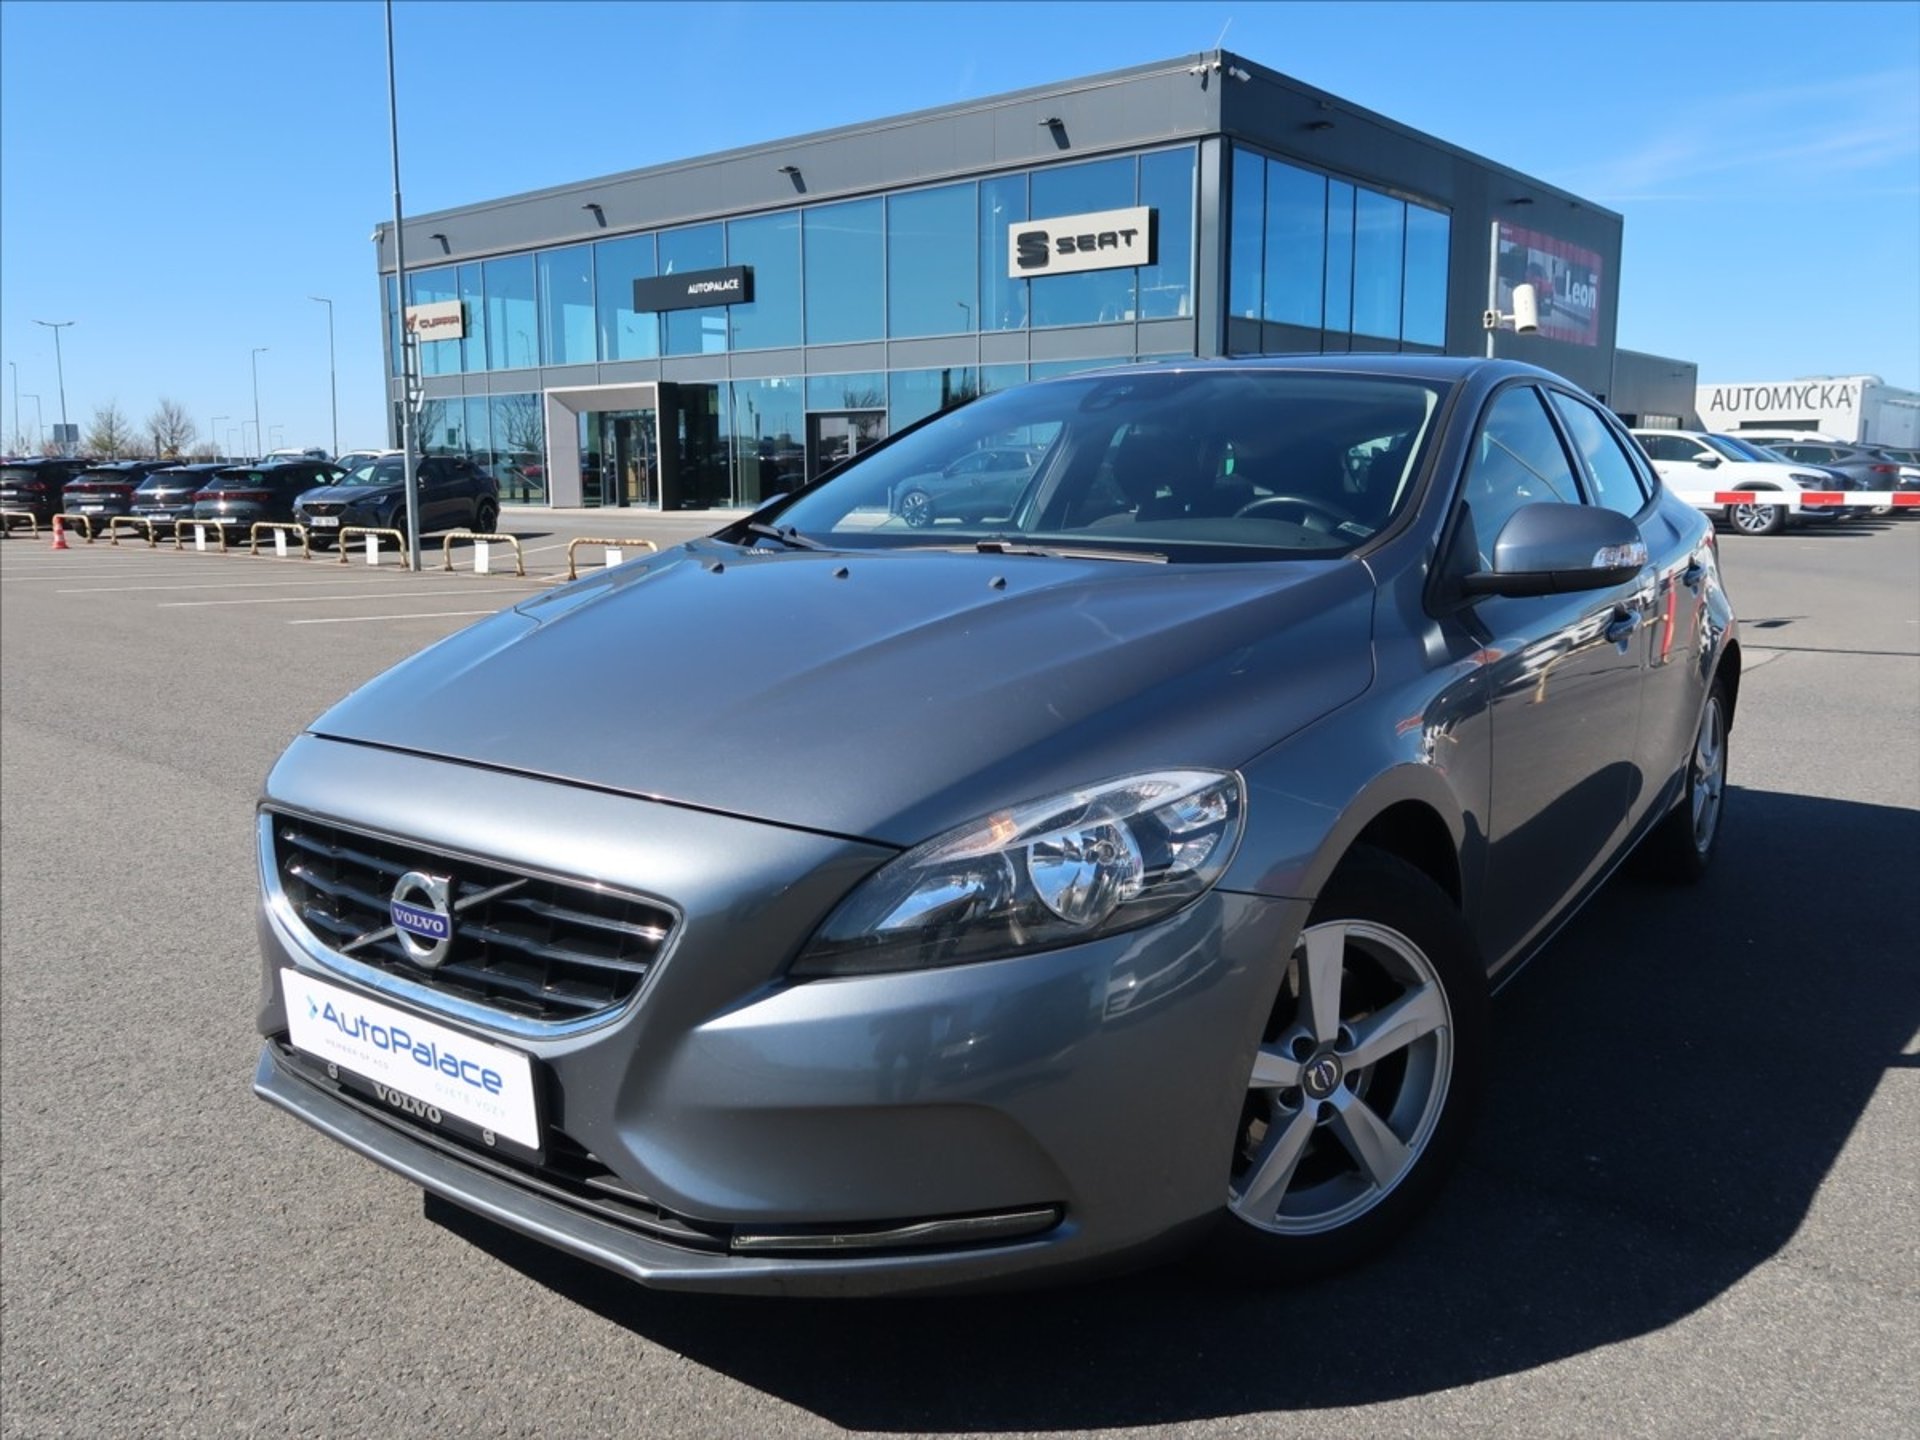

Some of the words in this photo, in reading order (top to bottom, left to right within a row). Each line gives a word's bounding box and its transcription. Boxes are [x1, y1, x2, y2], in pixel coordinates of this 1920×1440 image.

[1056, 229, 1138, 254] SEAT
[687, 278, 739, 295] AUTOPALACE
[1565, 269, 1597, 309] Leon
[1710, 382, 1852, 411] AUTOMYČKA
[393, 908, 445, 934] VOLVO
[322, 1001, 503, 1095] AutoPalace
[372, 1082, 442, 1124] VOLVO
